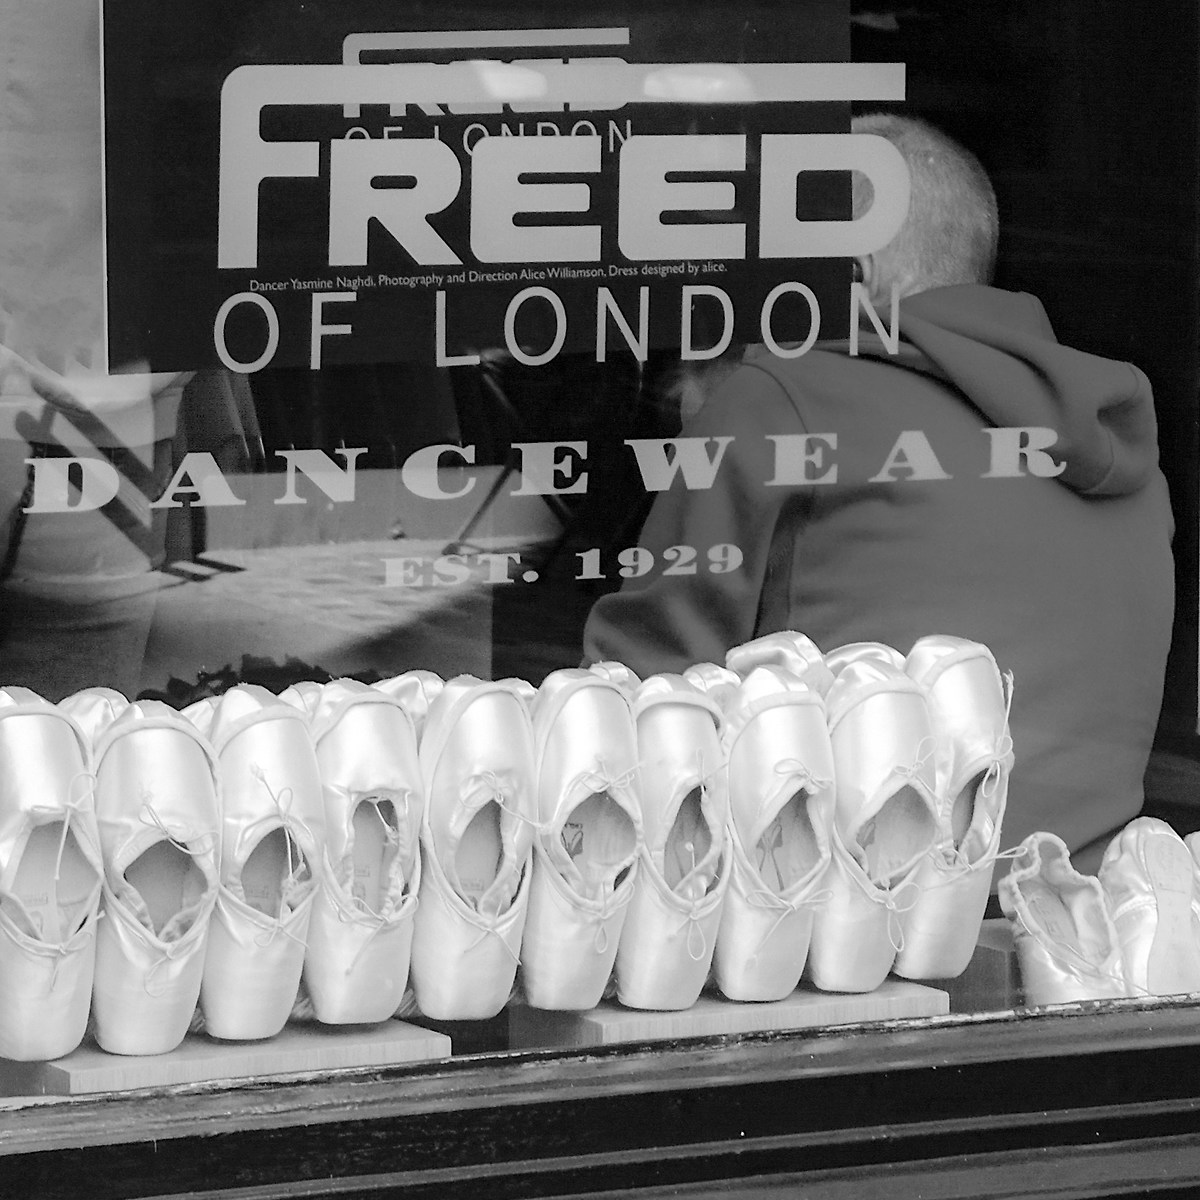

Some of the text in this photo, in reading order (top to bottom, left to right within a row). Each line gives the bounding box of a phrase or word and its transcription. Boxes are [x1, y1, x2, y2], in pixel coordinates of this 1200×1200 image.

[218, 61, 910, 269] FREED
[250, 279, 288, 292] Dancer
[290, 277, 333, 290] Yasmine
[378, 271, 443, 288] Photography
[446, 270, 466, 283] and
[468, 268, 518, 283] Direction
[519, 268, 546, 280] Alice
[608, 264, 638, 276] Dress
[641, 262, 685, 278] designed
[687, 261, 700, 276] by
[213, 280, 901, 374] OF LONDON
[22, 425, 1068, 515] DANCEWEAR
[379, 542, 745, 588] EST. 1929
